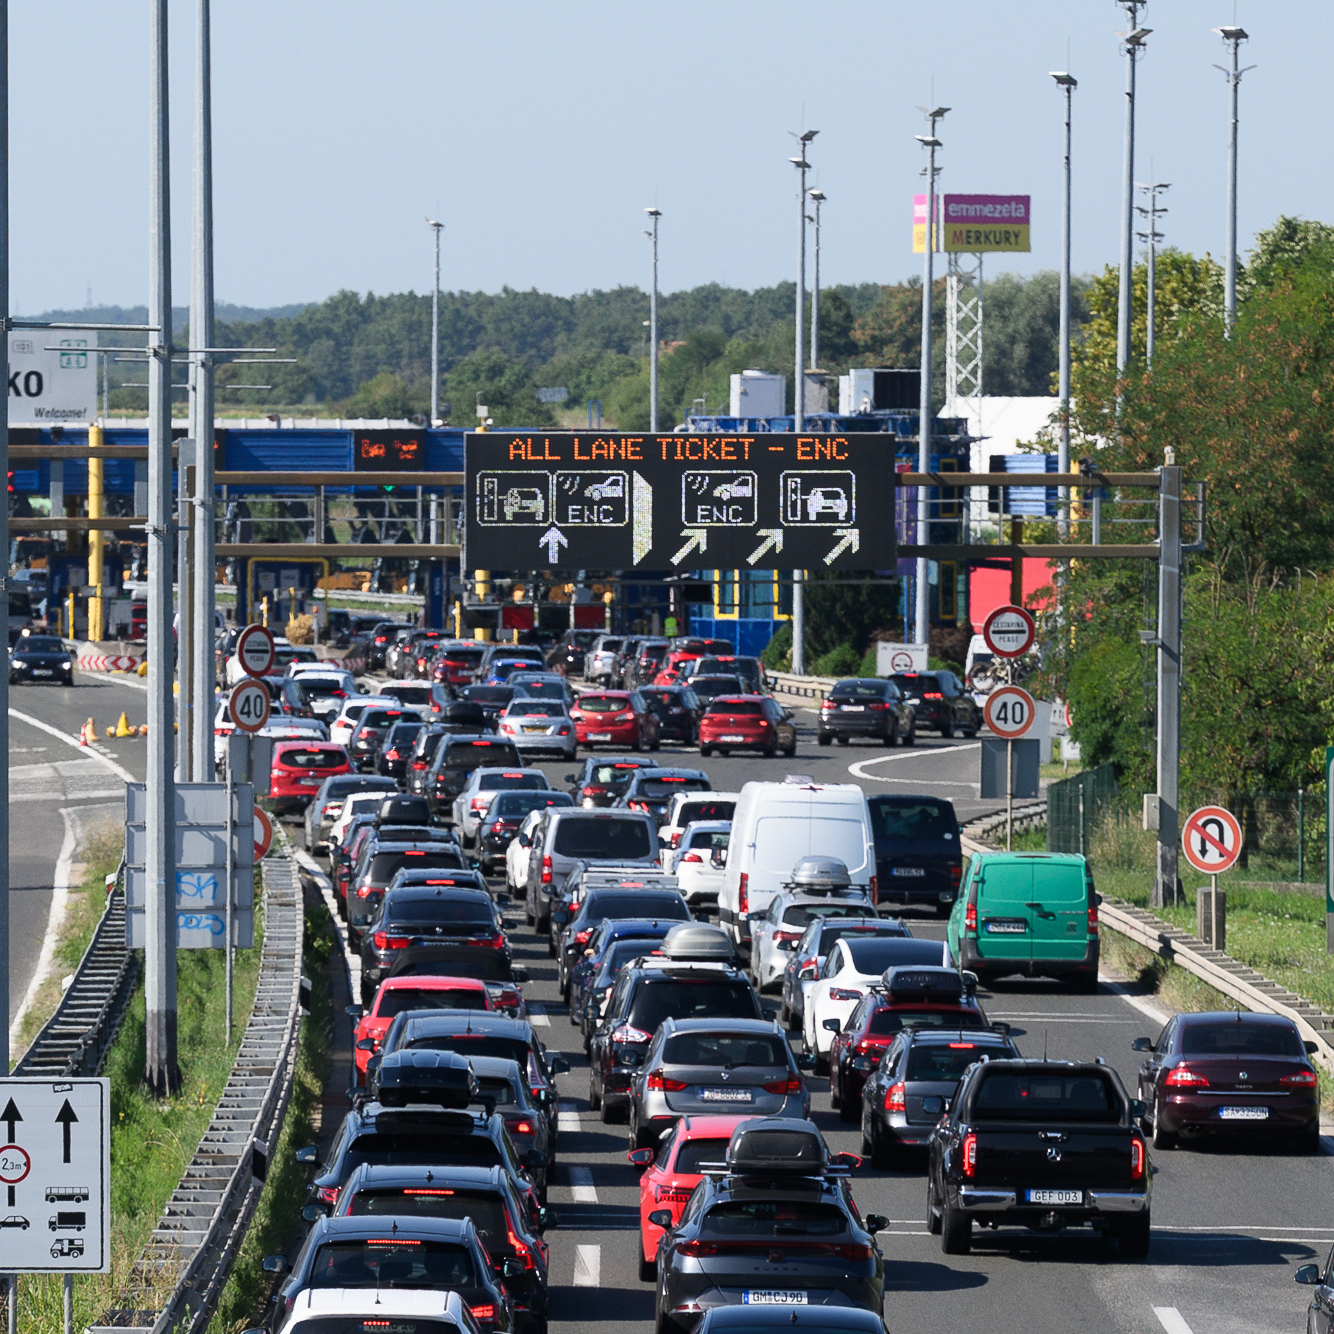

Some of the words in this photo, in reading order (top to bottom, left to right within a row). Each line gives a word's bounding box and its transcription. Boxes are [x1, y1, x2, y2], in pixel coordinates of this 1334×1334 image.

[948, 201, 1025, 218] emmezeta
[952, 230, 1021, 245] MERKURY
[34, 406, 87, 418] Welcome!
[508, 438, 561, 460] ALL
[573, 438, 643, 460] LANE
[656, 438, 755, 460] TICKET
[797, 438, 849, 460] ENC
[568, 506, 614, 523] ENC
[697, 506, 742, 523] ENC
[240, 694, 263, 719] 40
[995, 701, 1024, 725] 40
[1035, 1191, 1053, 1201] GEF
[1058, 1191, 1078, 1201] 003
